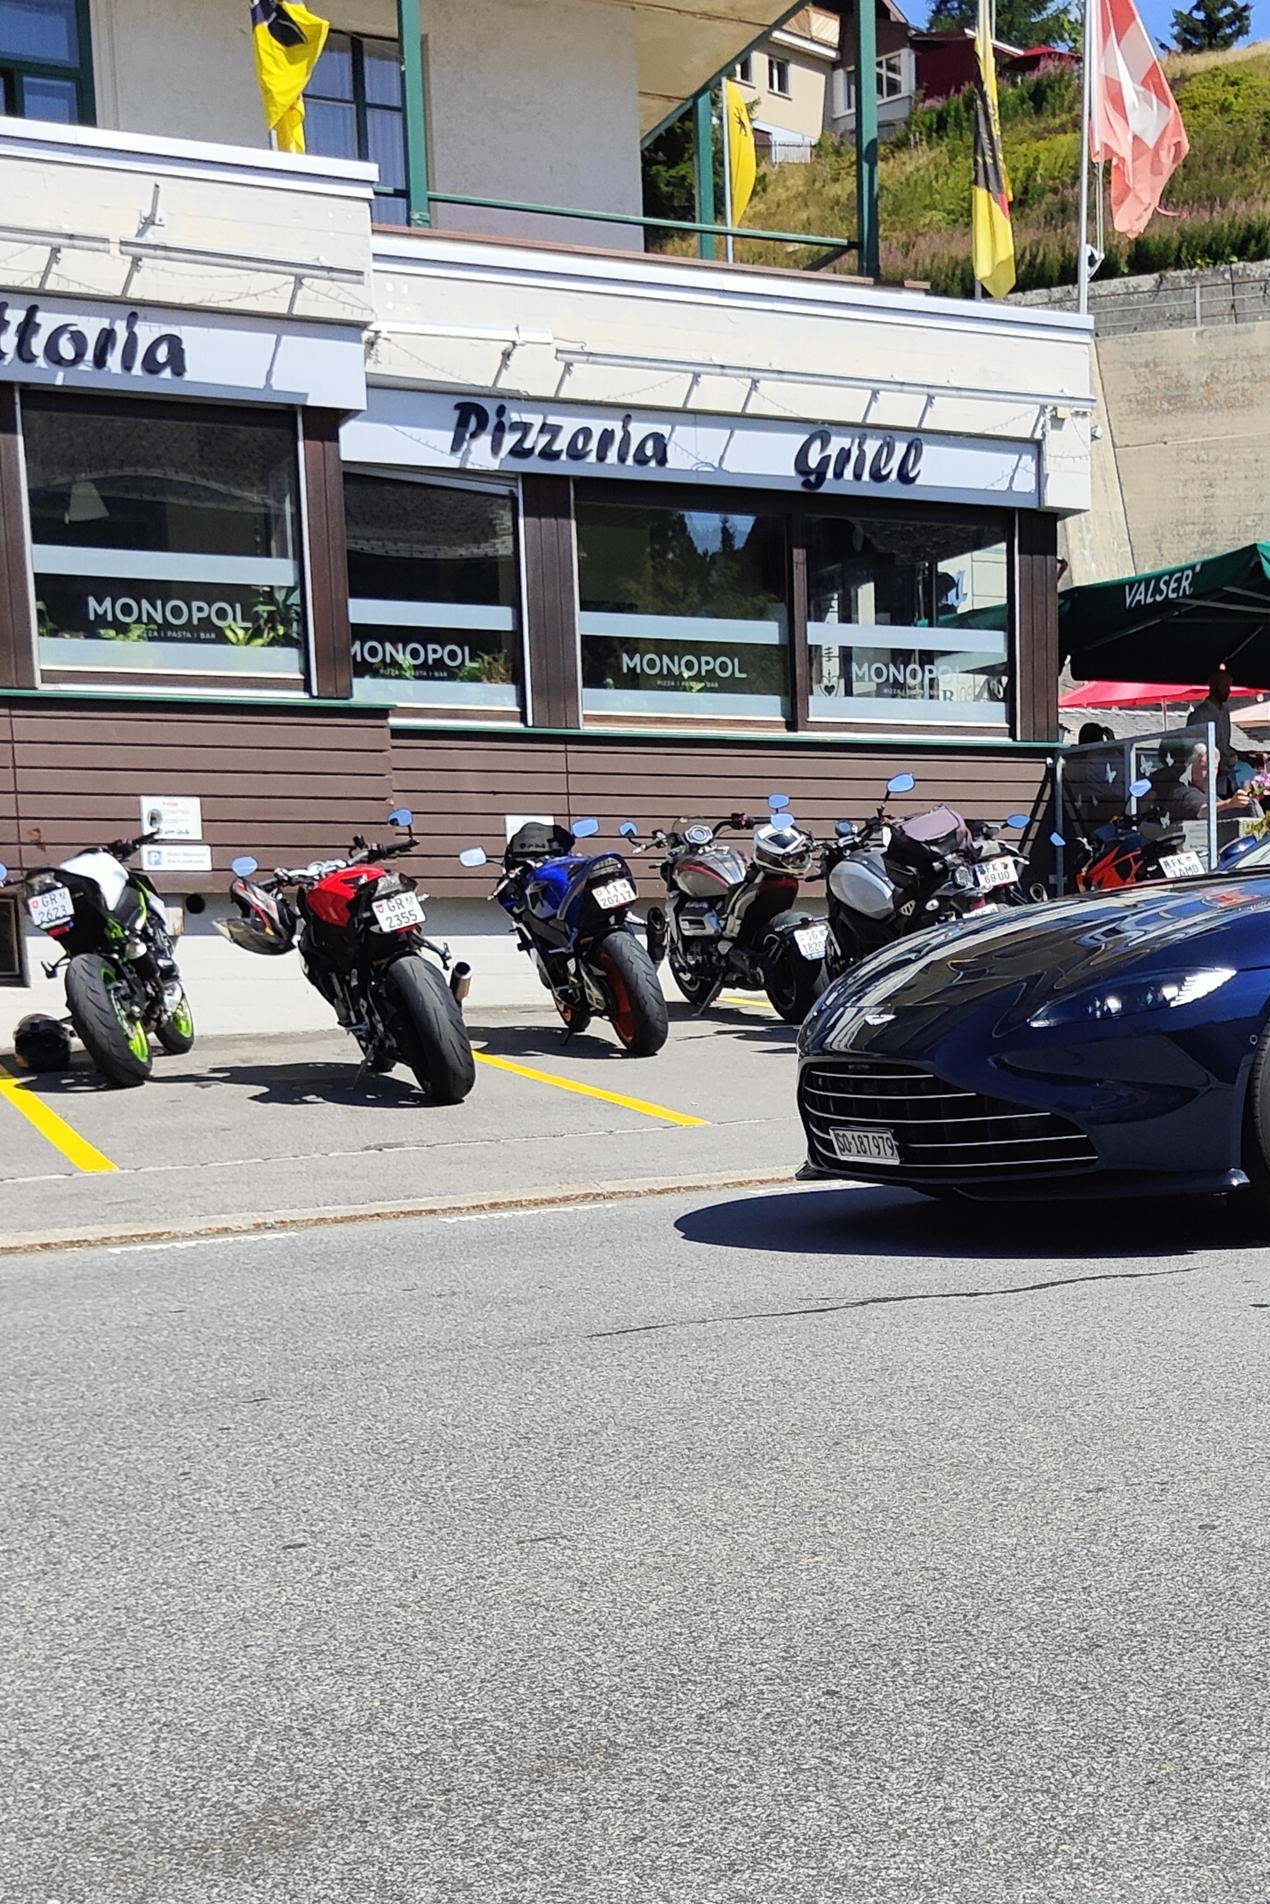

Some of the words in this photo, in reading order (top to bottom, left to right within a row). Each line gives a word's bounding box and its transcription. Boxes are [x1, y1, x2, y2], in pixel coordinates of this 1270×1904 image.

[450, 401, 669, 467] Pizzeria
[794, 429, 924, 490] Grill
[1125, 569, 1194, 609] VALSER
[88, 595, 253, 628] MONOPOL
[621, 652, 748, 678] MONOPOL
[41, 893, 58, 908] GR
[386, 897, 405, 912] GR
[385, 909, 418, 929] 2355
